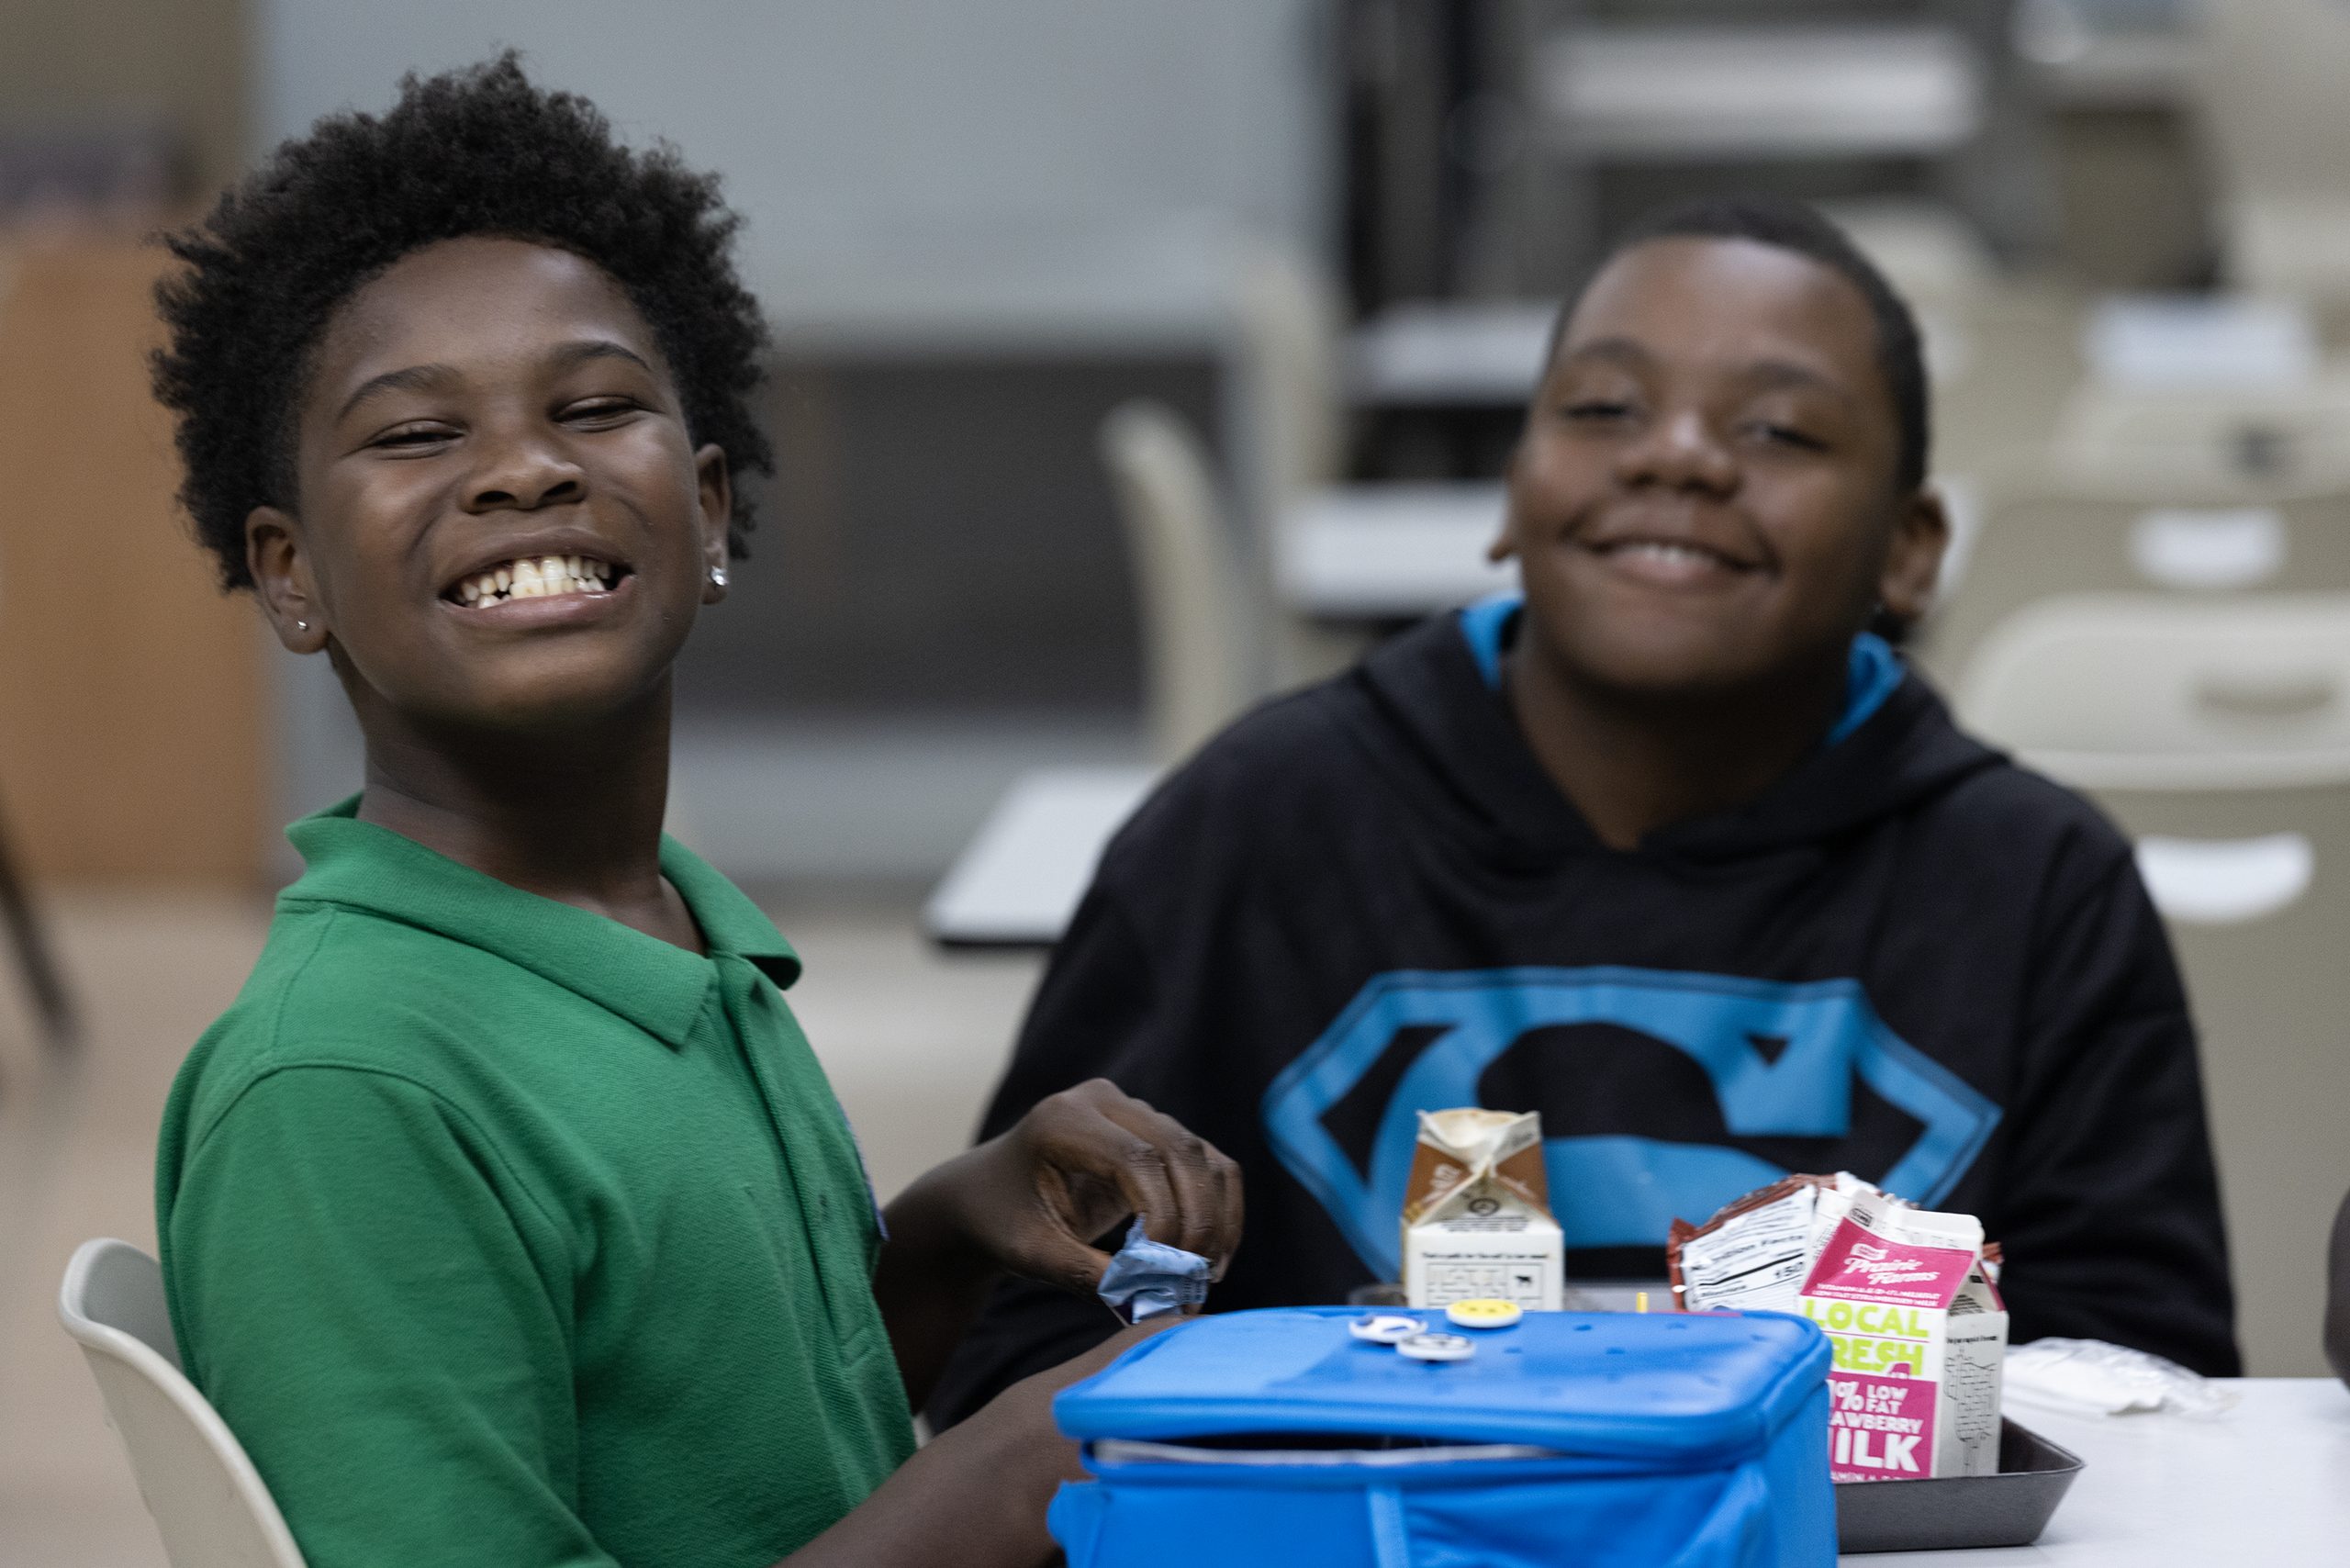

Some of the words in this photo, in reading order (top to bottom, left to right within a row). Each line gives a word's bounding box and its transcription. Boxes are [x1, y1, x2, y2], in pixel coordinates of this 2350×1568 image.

[1867, 1271, 1941, 1284] Farms
[1806, 1299, 1929, 1338] LOCAL
[1831, 1336, 1923, 1375] RESH
[1866, 1384, 1908, 1401] LOW
[1865, 1398, 1902, 1415] FAT
[1830, 1410, 1924, 1434] AWBERRY
[1830, 1427, 1923, 1473] ILK
